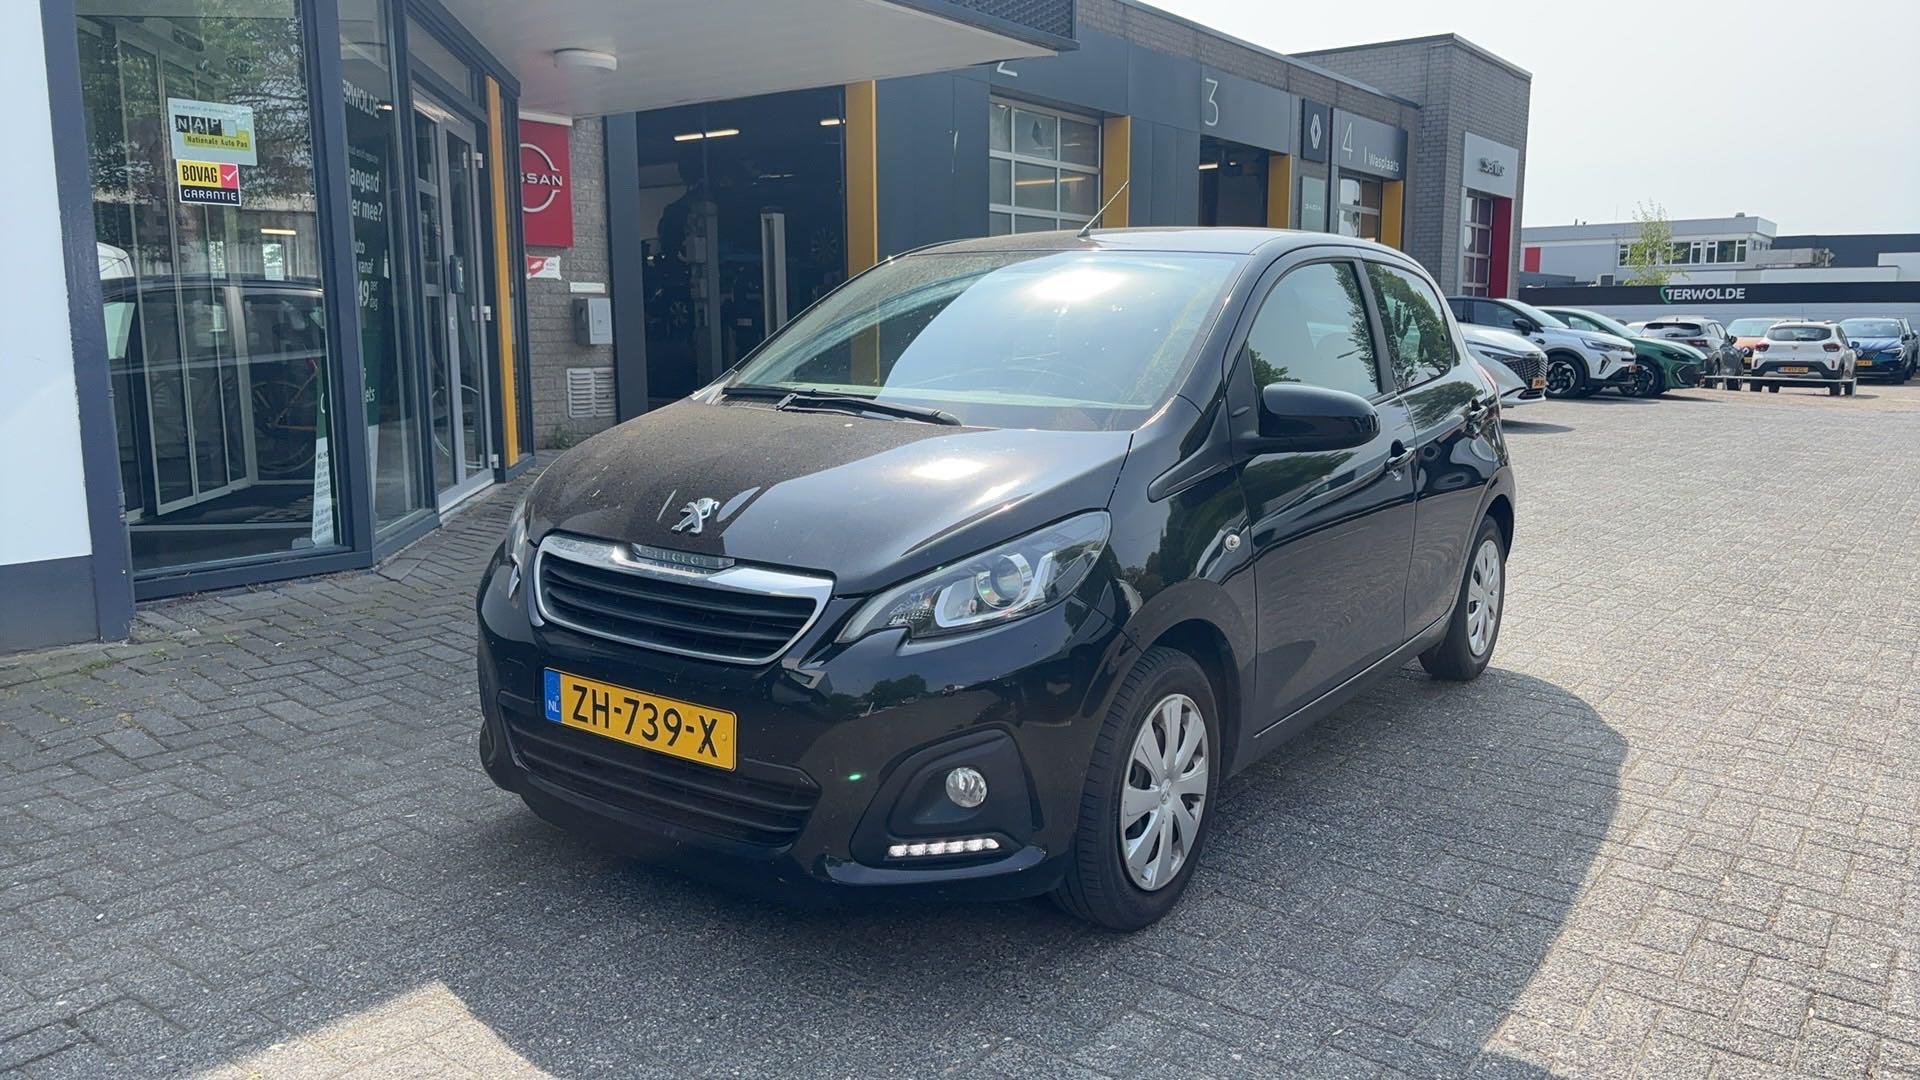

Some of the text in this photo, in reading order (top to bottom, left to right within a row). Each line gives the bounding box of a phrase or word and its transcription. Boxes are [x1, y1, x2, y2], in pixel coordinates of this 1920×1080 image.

[1205, 77, 1219, 126] 3
[177, 118, 219, 130] NAP
[1342, 121, 1399, 172] 4 Wasplaats
[182, 165, 218, 183] BOVAG
[350, 168, 379, 193] angend
[183, 189, 236, 201] GARANTIE
[362, 201, 383, 222] mee?
[1665, 288, 1745, 301] TERWOLDE
[548, 700, 559, 713] NL
[572, 684, 718, 758] ZH-739-X
